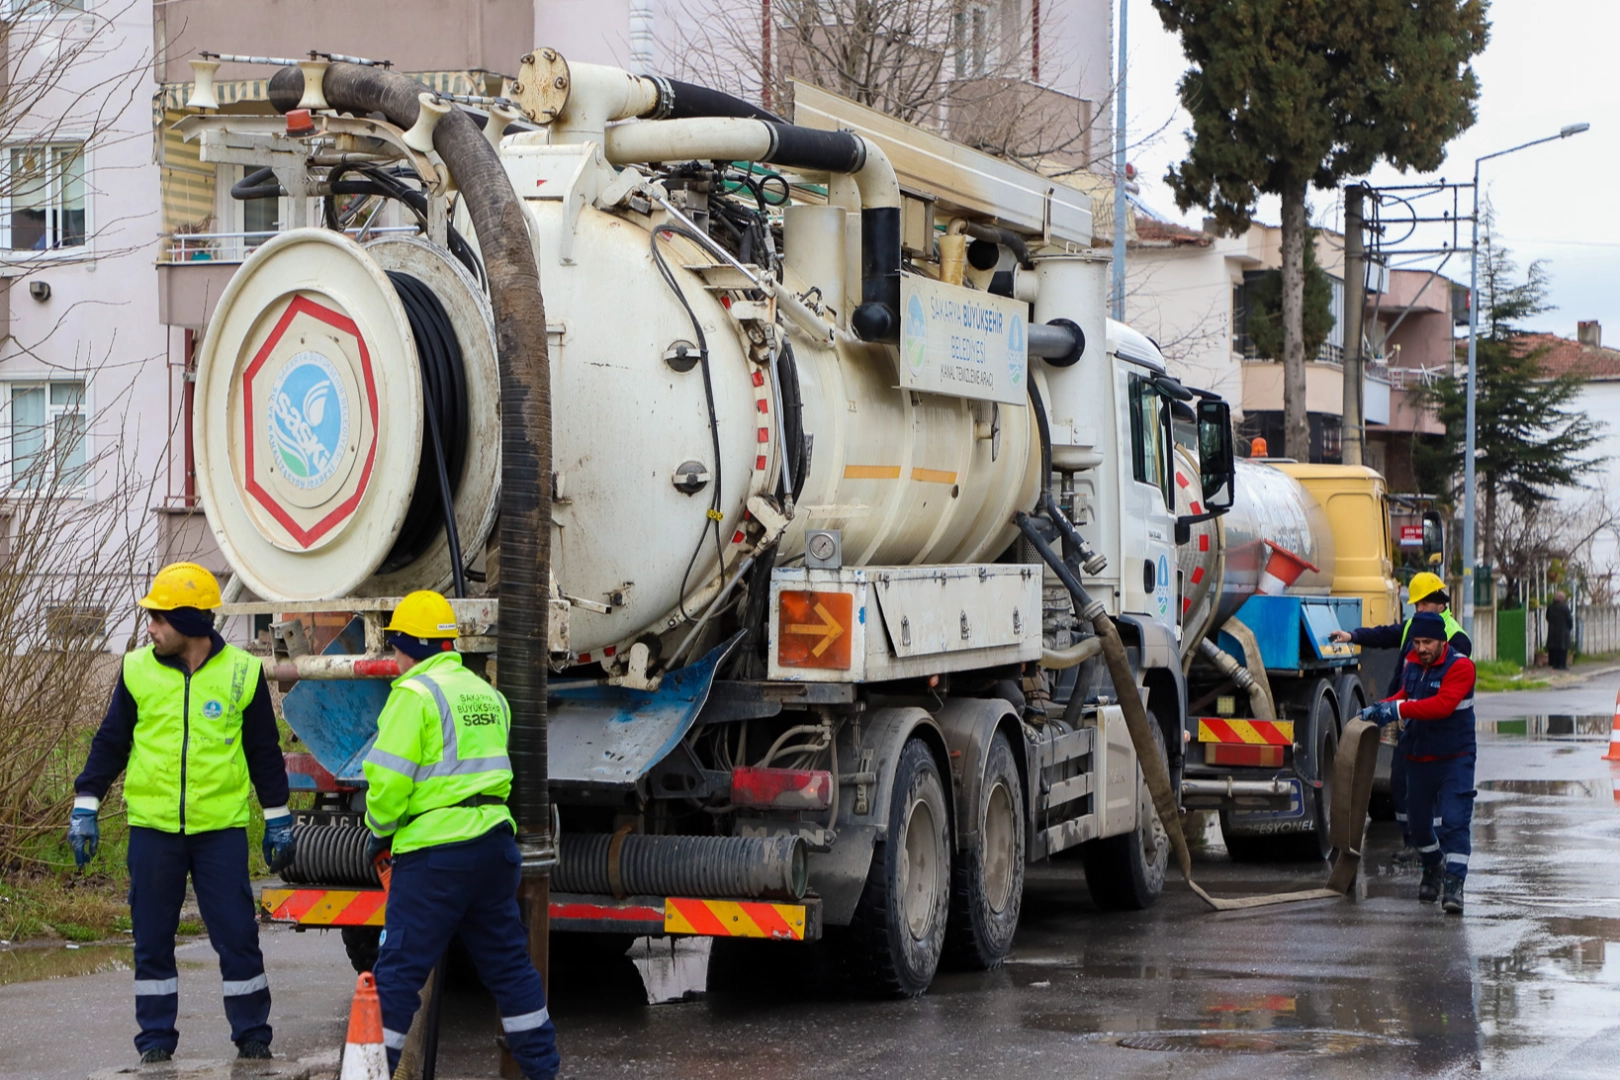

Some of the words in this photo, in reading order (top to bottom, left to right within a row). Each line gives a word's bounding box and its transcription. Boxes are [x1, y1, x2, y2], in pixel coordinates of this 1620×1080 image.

[930, 296, 962, 323] SAKARYA
[963, 300, 1003, 336] BÜYÜKŞEHİR
[951, 335, 986, 364] BELEDİYESİ
[940, 363, 956, 380] KANAL
